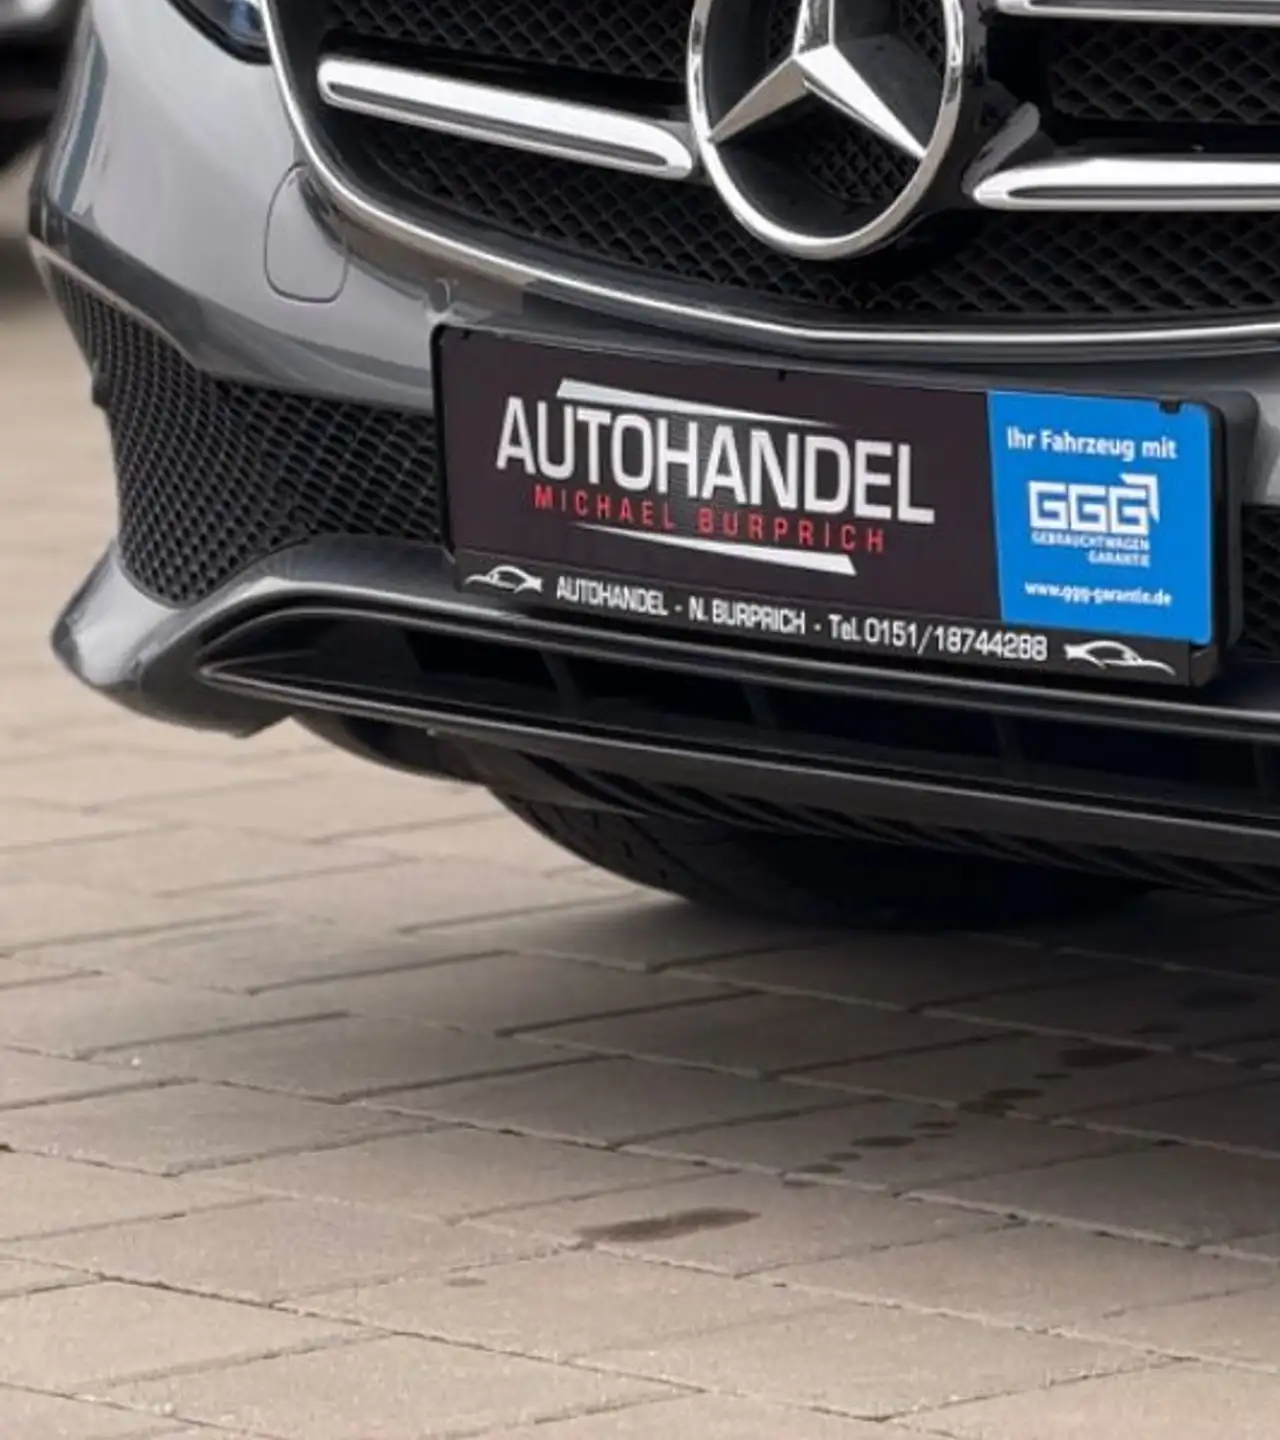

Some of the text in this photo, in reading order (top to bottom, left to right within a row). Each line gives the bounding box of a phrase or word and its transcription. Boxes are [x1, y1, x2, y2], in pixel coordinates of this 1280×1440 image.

[496, 396, 935, 523] AUTOHANDEL
[1006, 426, 1178, 462] Ihr Fahrzeug mit
[534, 484, 884, 554] MICHAEL BURPRICH
[1028, 479, 1149, 536] GGG
[557, 576, 668, 615] AUTOHANDEL
[712, 598, 805, 634] BURPRICH
